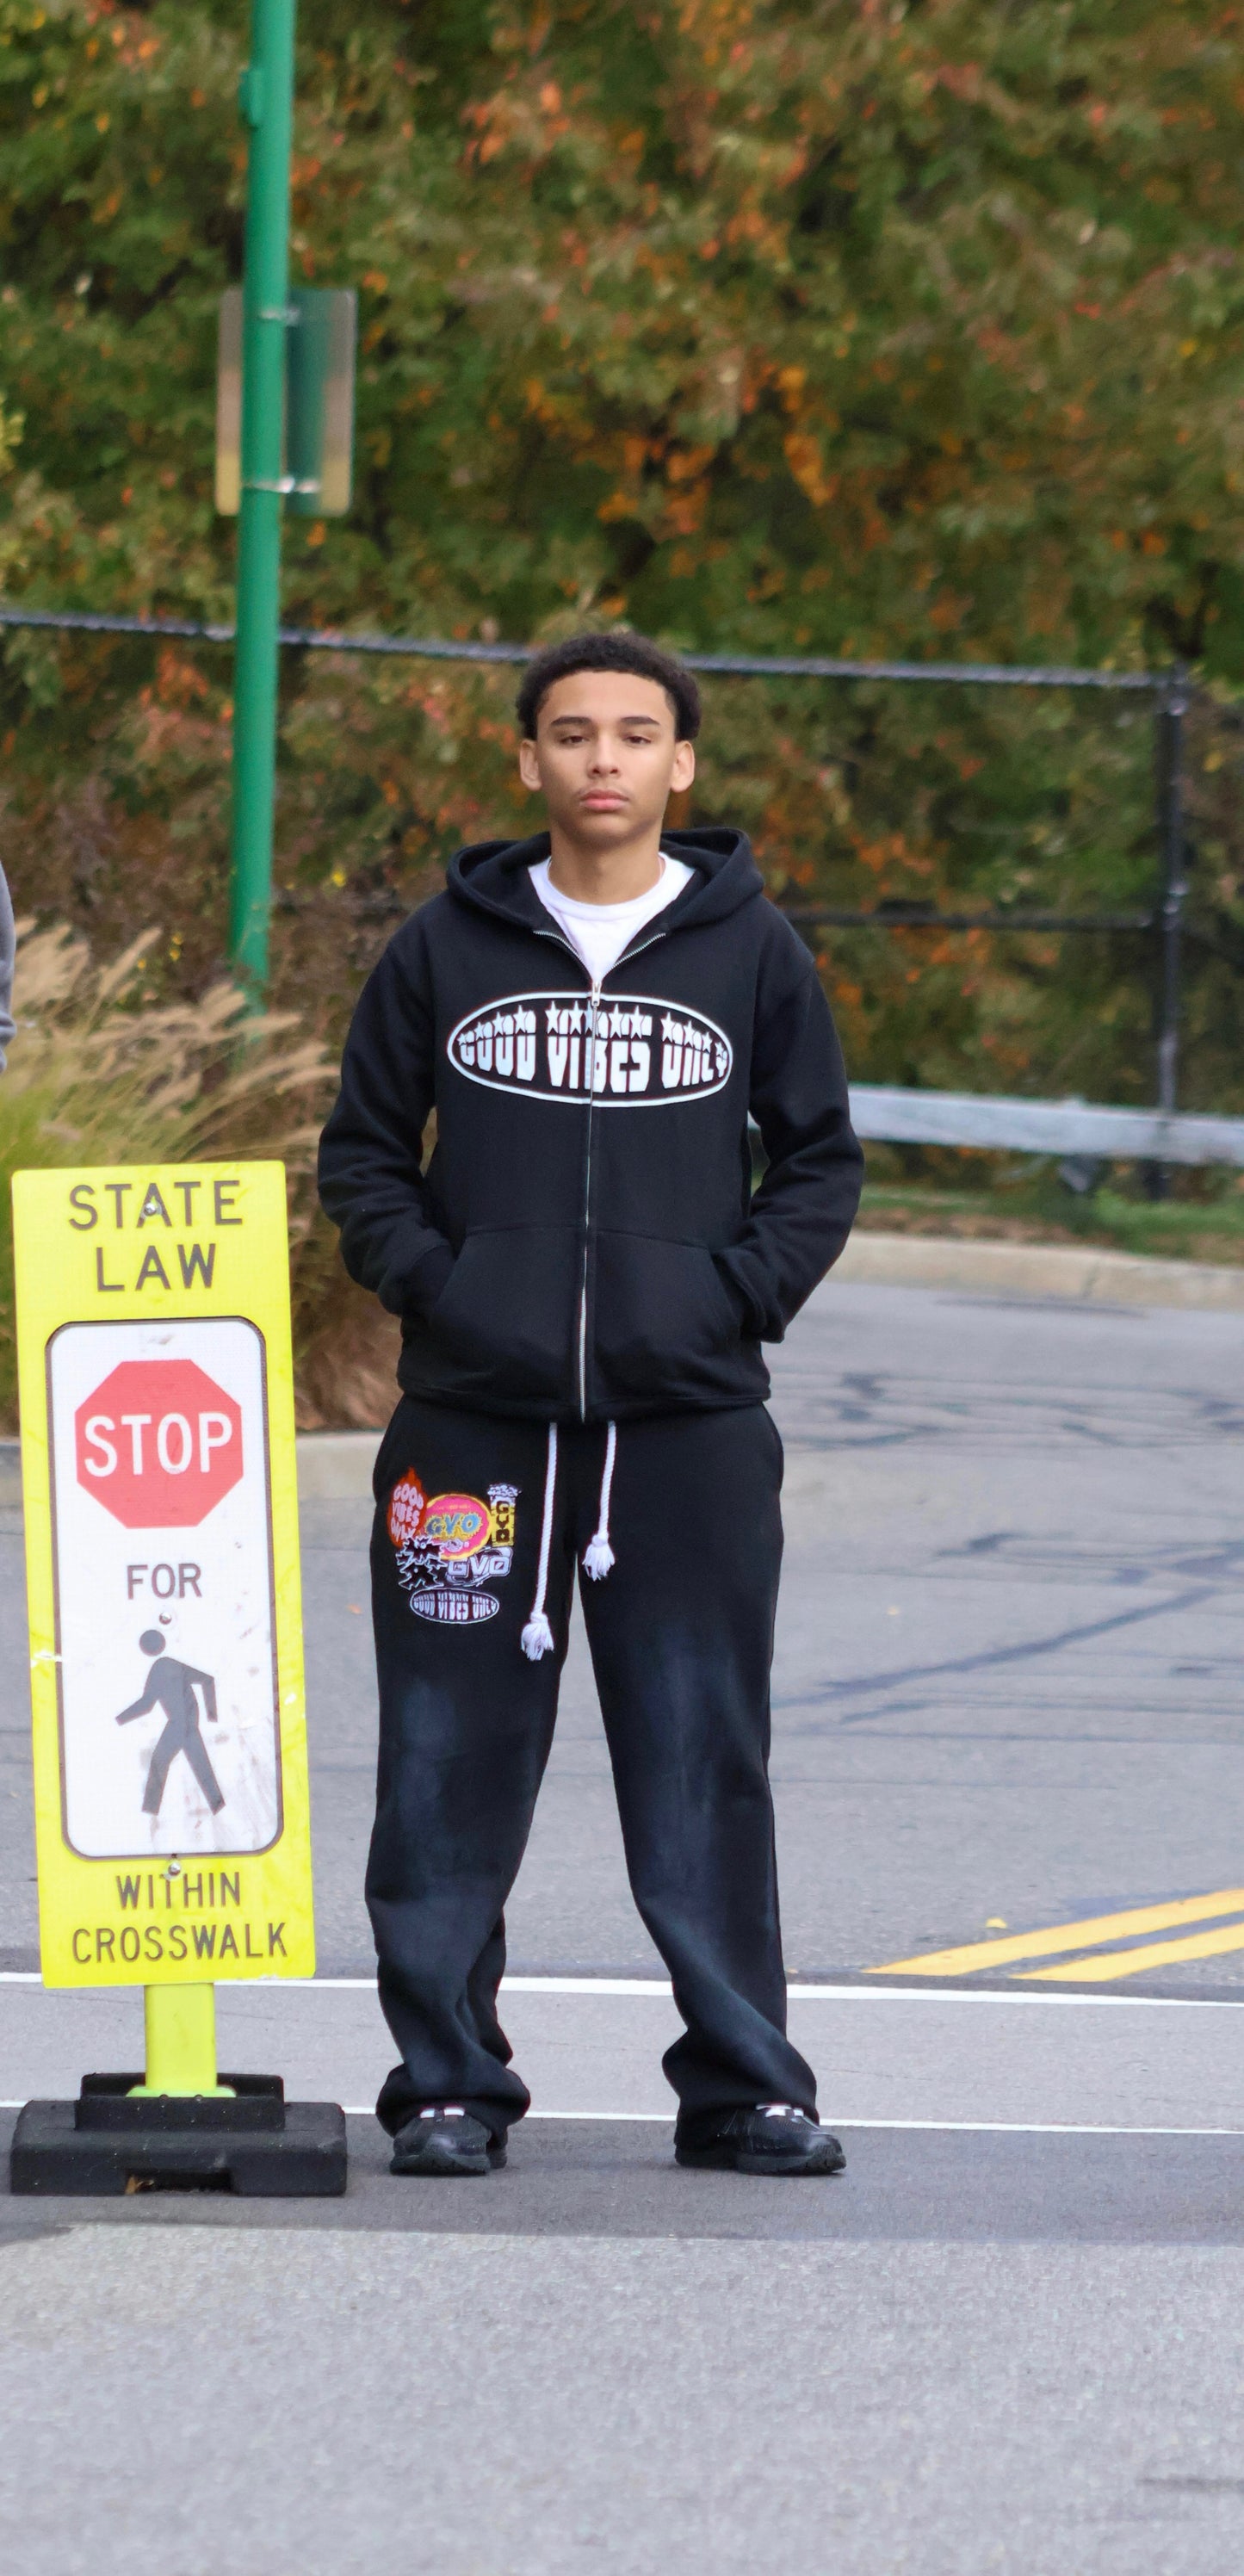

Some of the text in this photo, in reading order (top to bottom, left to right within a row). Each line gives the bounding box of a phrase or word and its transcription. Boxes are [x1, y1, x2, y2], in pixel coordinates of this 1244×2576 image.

[457, 1000, 729, 1093] GOOD VIBES ONLY
[68, 1180, 243, 1231] STATE
[96, 1242, 216, 1291] LAW
[84, 1412, 232, 1477] STOP
[392, 1502, 420, 1526] VIBES
[393, 1483, 424, 1509] GOOD
[426, 1513, 482, 1537] GVO
[127, 1564, 202, 1600] FOR
[448, 1556, 511, 1576] GVO
[413, 1591, 497, 1620] GOOD VIBES ONLY
[115, 1872, 241, 1909] WITHIN
[71, 1922, 288, 1964] CROSSWALK
